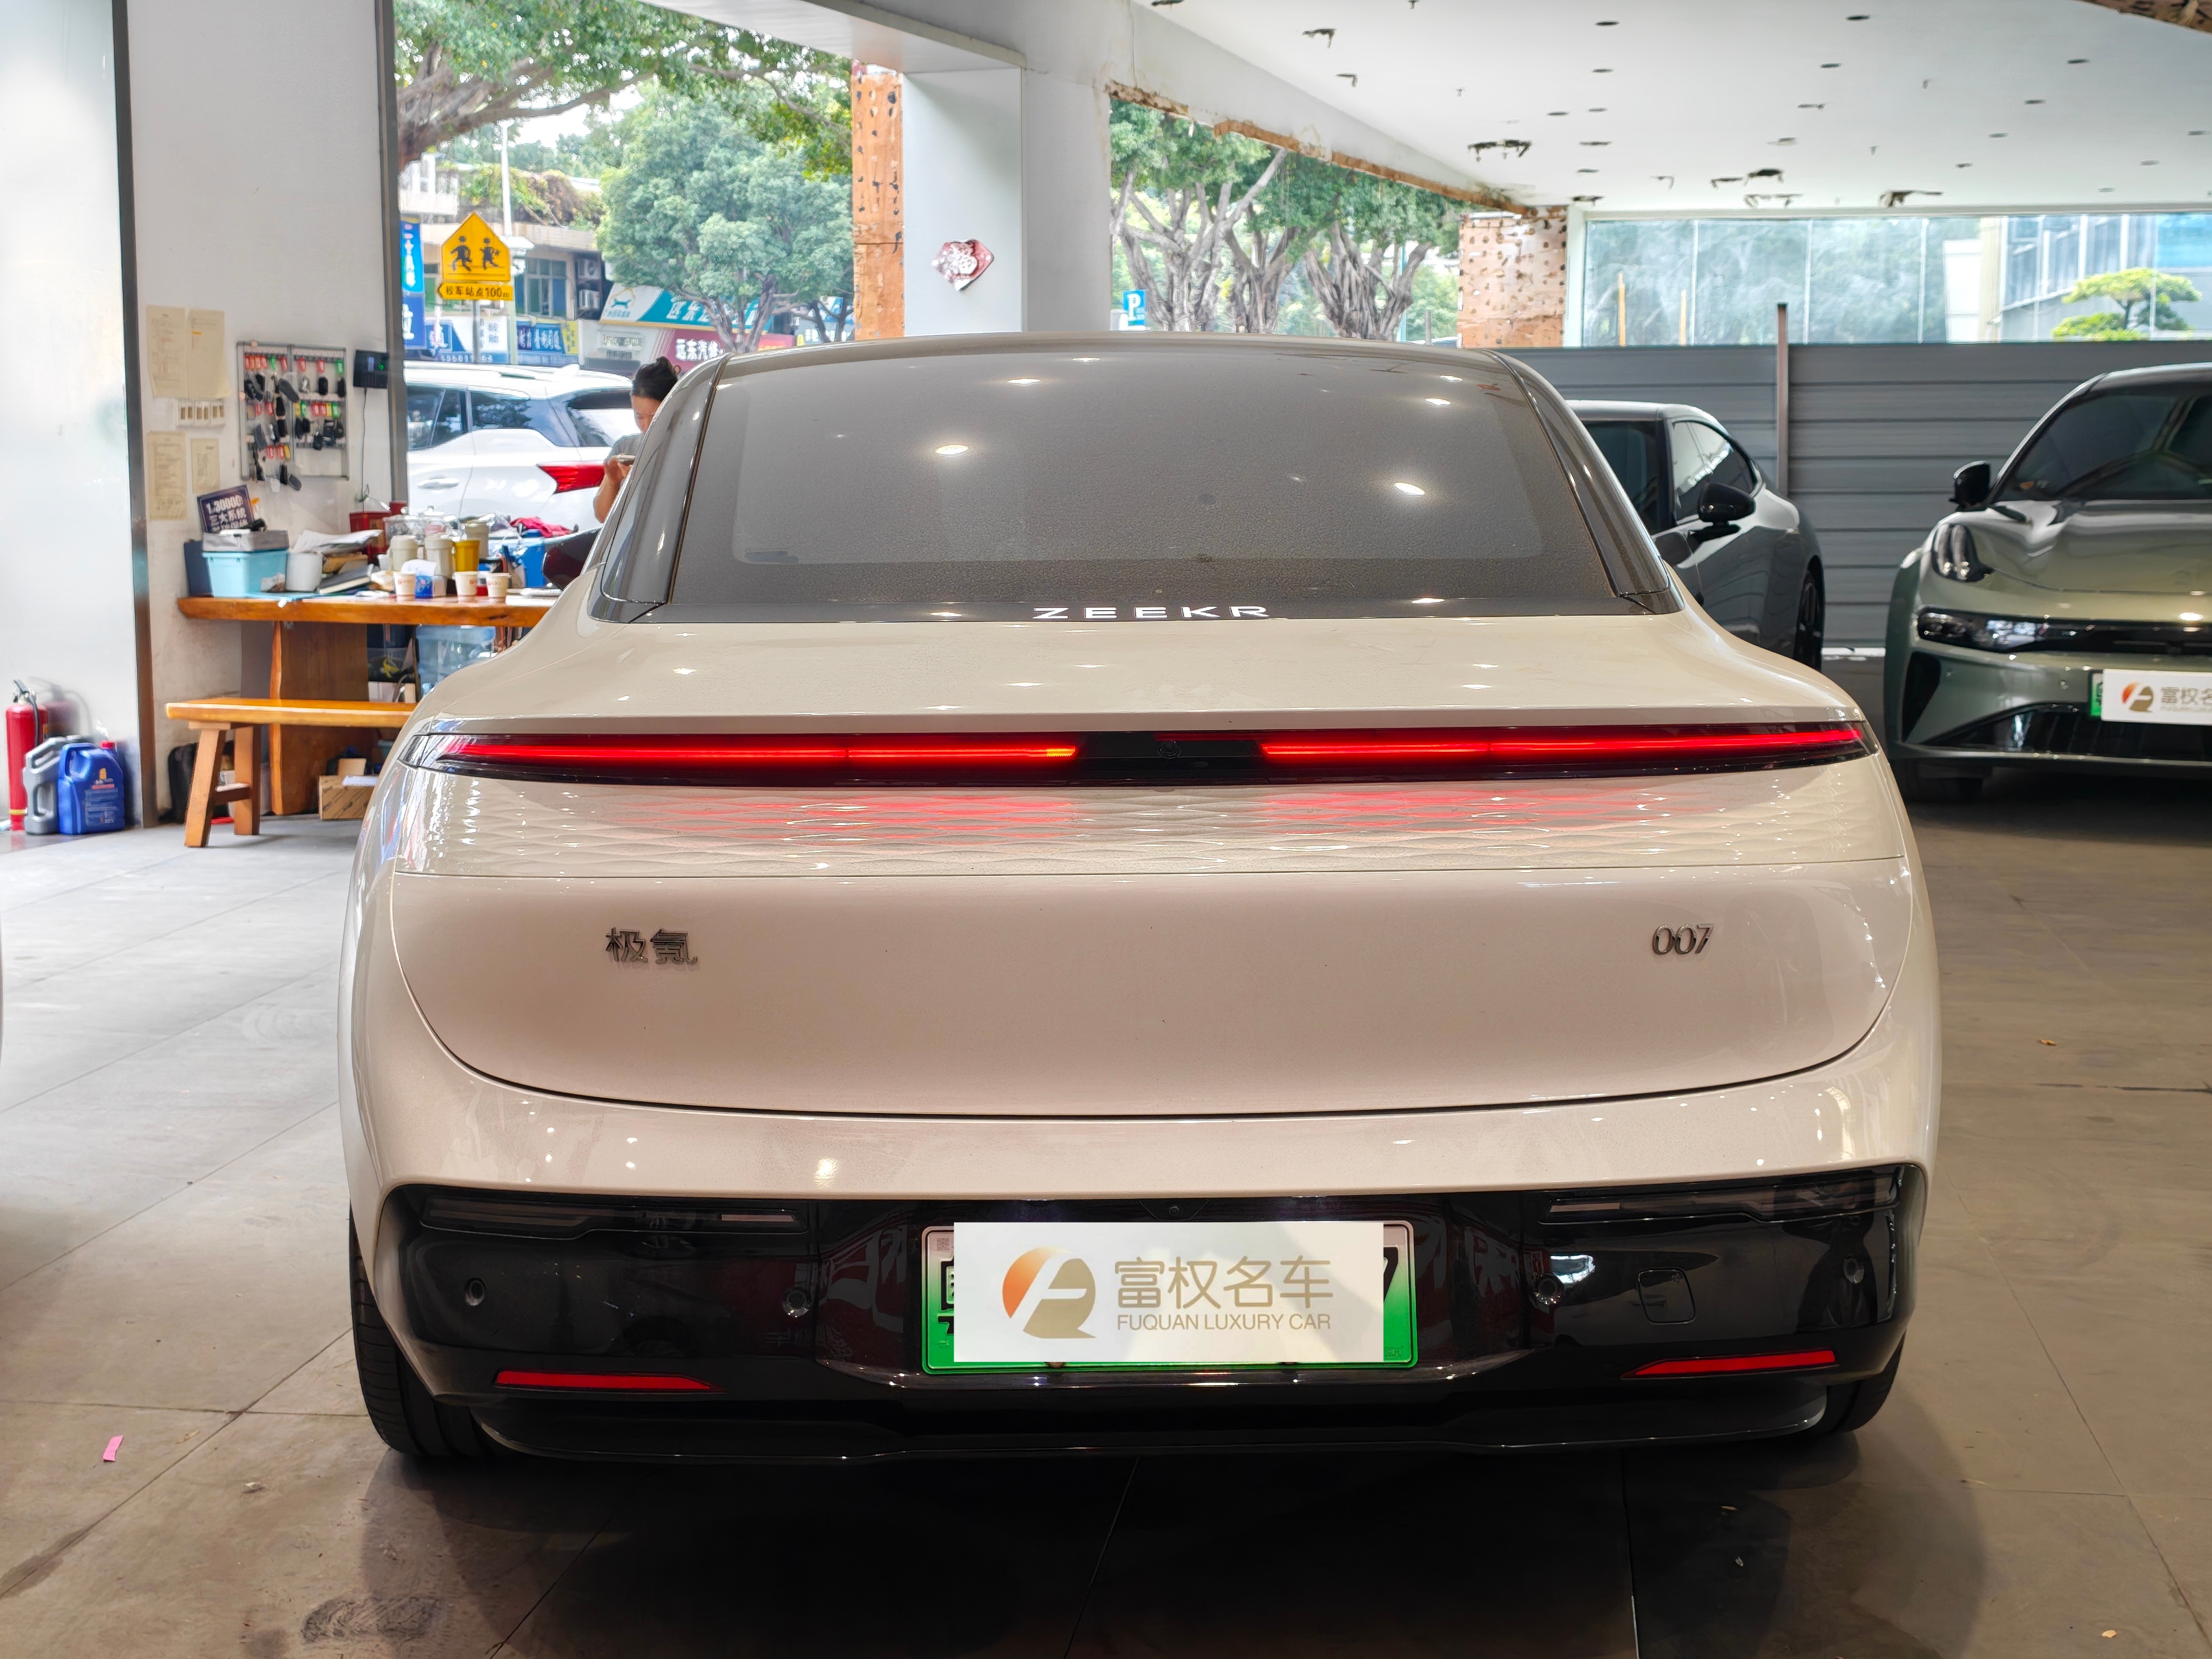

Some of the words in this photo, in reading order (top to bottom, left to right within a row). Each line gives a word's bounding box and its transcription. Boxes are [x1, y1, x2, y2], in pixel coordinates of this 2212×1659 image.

[1127, 293, 1141, 320] P
[1033, 606, 1269, 619] ZEEKR
[605, 927, 698, 965] 极氪
[1652, 923, 1715, 955] 007
